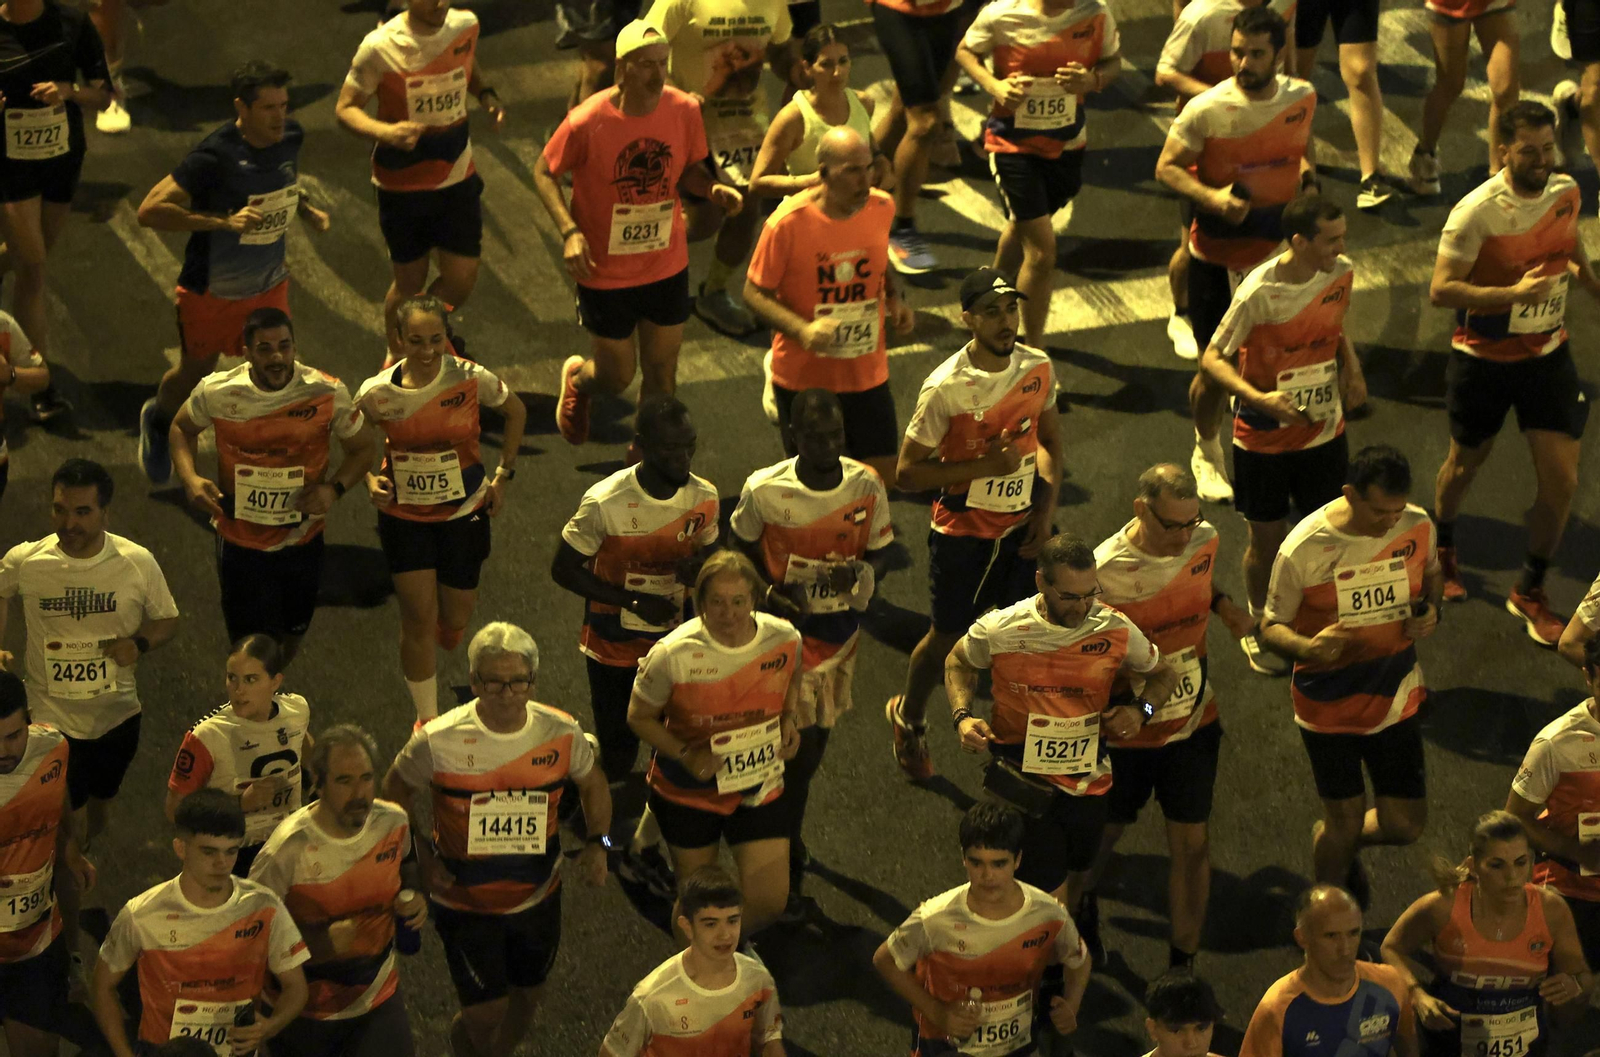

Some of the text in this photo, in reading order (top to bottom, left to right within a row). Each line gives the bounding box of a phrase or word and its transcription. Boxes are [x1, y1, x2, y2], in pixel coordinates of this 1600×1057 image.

[415, 91, 460, 113] 21595
[1027, 98, 1065, 115] 6156
[14, 125, 61, 145] 12727
[719, 145, 762, 169] 247
[622, 222, 659, 240] 6231
[818, 283, 866, 304] TUR
[407, 473, 449, 490] 4075
[985, 479, 1023, 497] 1168
[247, 489, 290, 508] 4077
[1352, 585, 1396, 610] 8104
[1081, 640, 1109, 655] KH7
[52, 660, 107, 682] 24261
[1034, 738, 1090, 759] 15217
[532, 752, 557, 767] KH7
[723, 744, 775, 774] 15443
[479, 817, 537, 836] 14415
[974, 1019, 1020, 1043] 1566
[1476, 1035, 1523, 1057] 9451
